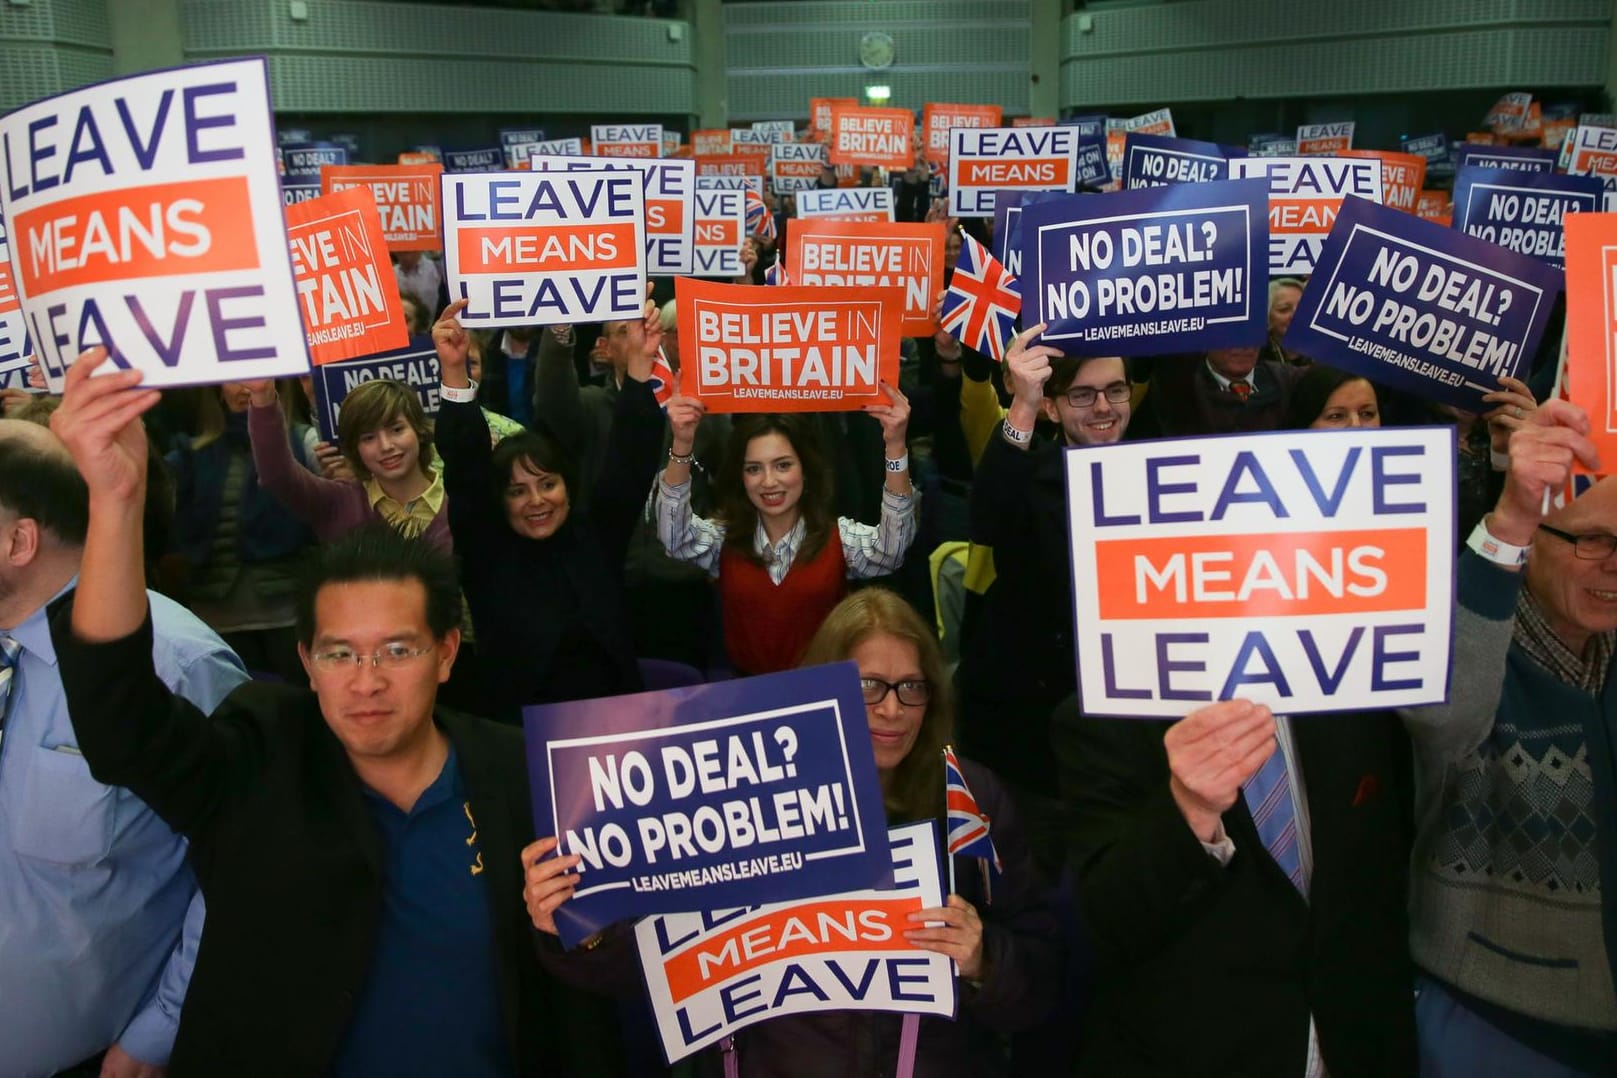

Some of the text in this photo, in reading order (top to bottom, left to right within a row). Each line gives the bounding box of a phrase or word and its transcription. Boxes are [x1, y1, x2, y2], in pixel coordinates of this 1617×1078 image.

[3, 81, 245, 201] LEAVE
[595, 127, 659, 142] LEAVE
[732, 129, 779, 144] LEAVE
[839, 117, 892, 134] BELIEVE
[931, 114, 980, 128] BELIEVE
[1301, 124, 1352, 140] LEAVE
[603, 144, 653, 157] MEANS
[839, 133, 906, 154] BRITAIN
[957, 131, 1071, 156] LEAVE
[776, 177, 818, 191] LEAV
[971, 164, 1056, 183] MEANS
[1142, 154, 1164, 178] NO
[1166, 158, 1218, 183] DEAL?
[414, 182, 433, 202] IN
[456, 178, 635, 221] LEAVE
[803, 191, 889, 213] LEAVE
[1488, 194, 1519, 223] NO
[29, 199, 212, 280] MEANS
[338, 222, 370, 263] IN
[481, 232, 618, 265] MEANS
[803, 243, 930, 273] BELIEVE IN
[1069, 231, 1114, 272] NO
[1121, 220, 1218, 268] DEAL?
[459, 274, 640, 319] LEAVE
[1047, 267, 1243, 321] NO PROBLEM!
[1367, 246, 1418, 293] NO
[1417, 264, 1513, 326] DEAL?
[30, 284, 278, 380] LEAVE
[699, 309, 877, 344] BELIEVE IN
[1084, 316, 1205, 342] LEAVEMEANSLEAVE.EU
[1326, 281, 1518, 378] NO PROBLEM!
[700, 344, 877, 387] BRITAIN
[1348, 336, 1465, 388] LEAVEMEANSLEAVE.EU
[733, 388, 844, 399] LEAVEMEANSLEAVE.EU
[1090, 444, 1428, 528] LEAVE
[1134, 545, 1388, 604] MEANS
[1100, 623, 1426, 702] LEAVE
[588, 725, 799, 812] NO DEAL?
[566, 827, 633, 873] NO
[637, 782, 850, 865] PROBLEM!
[632, 851, 803, 892] LEAVEMEANSLEAVE.EU
[697, 910, 893, 981] MEANS
[675, 957, 936, 1047] LEAVE
